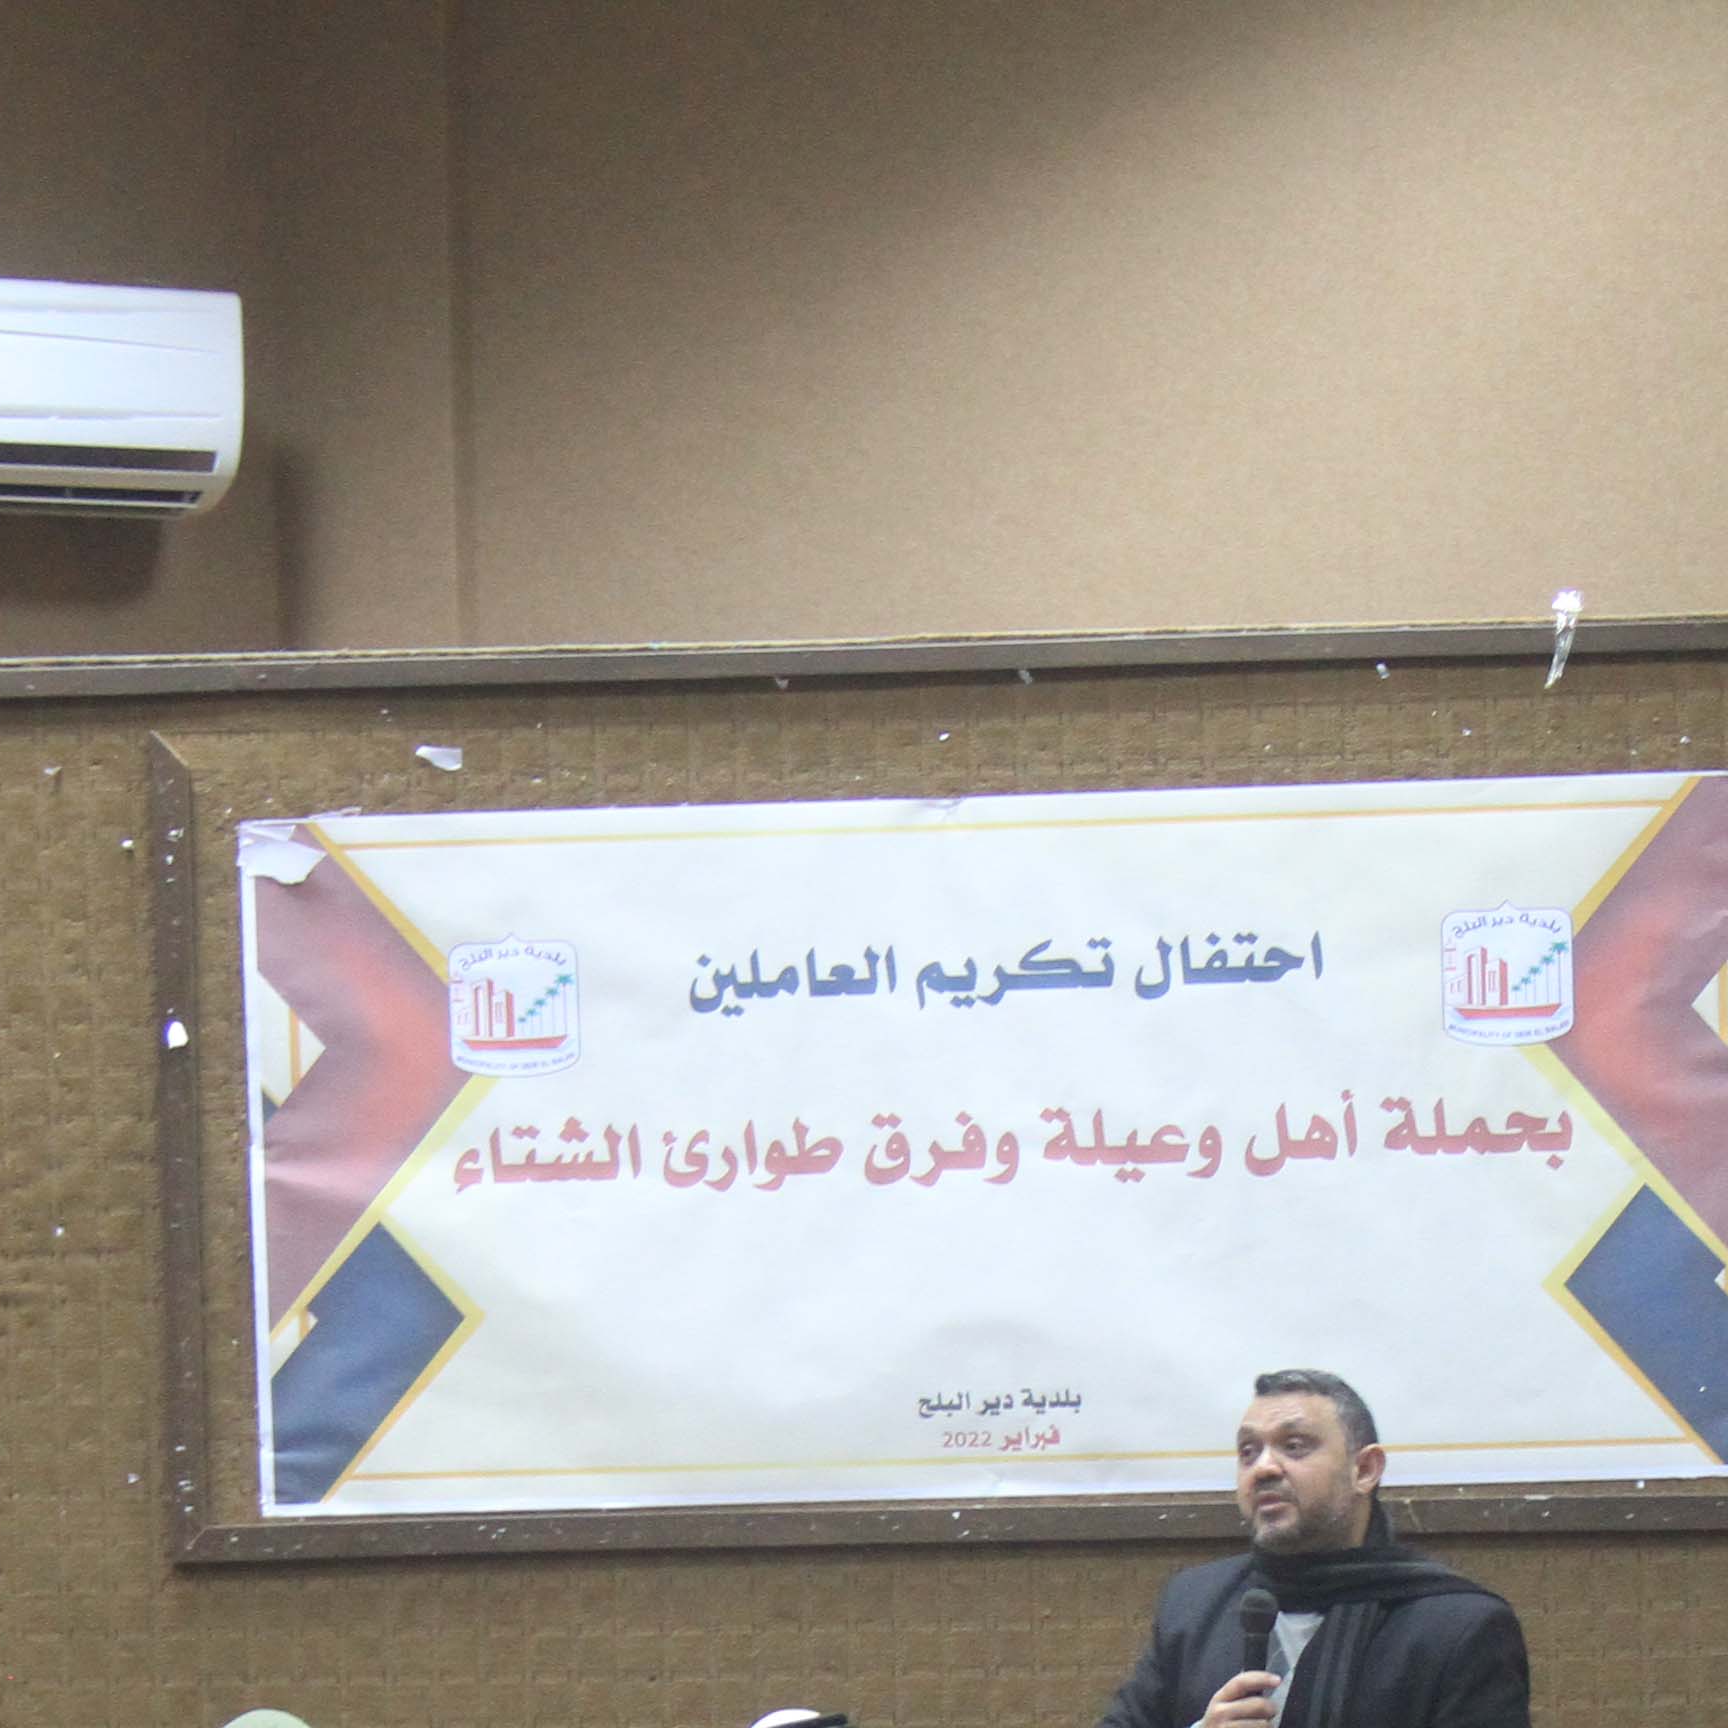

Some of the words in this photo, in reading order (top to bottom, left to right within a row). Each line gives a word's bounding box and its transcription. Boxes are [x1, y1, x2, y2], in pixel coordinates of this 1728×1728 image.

[689, 944, 898, 1018] العاملين
[915, 937, 1116, 1010] تكريم
[1134, 929, 1324, 1000] احتفال
[453, 1115, 642, 1195] الشتاء
[661, 1116, 845, 1193] طوارئ
[863, 1110, 1020, 1187] وفرق
[1039, 1106, 1224, 1184] وعيلة
[1244, 1089, 1358, 1177] أهل
[1379, 1095, 1574, 1171] بحملة
[917, 1391, 971, 1418] البلح
[977, 1393, 1014, 1416] دير
[997, 1423, 1061, 1451] فبراير
[1020, 1387, 1082, 1414] بلدية
[942, 1431, 992, 1448] 2022
